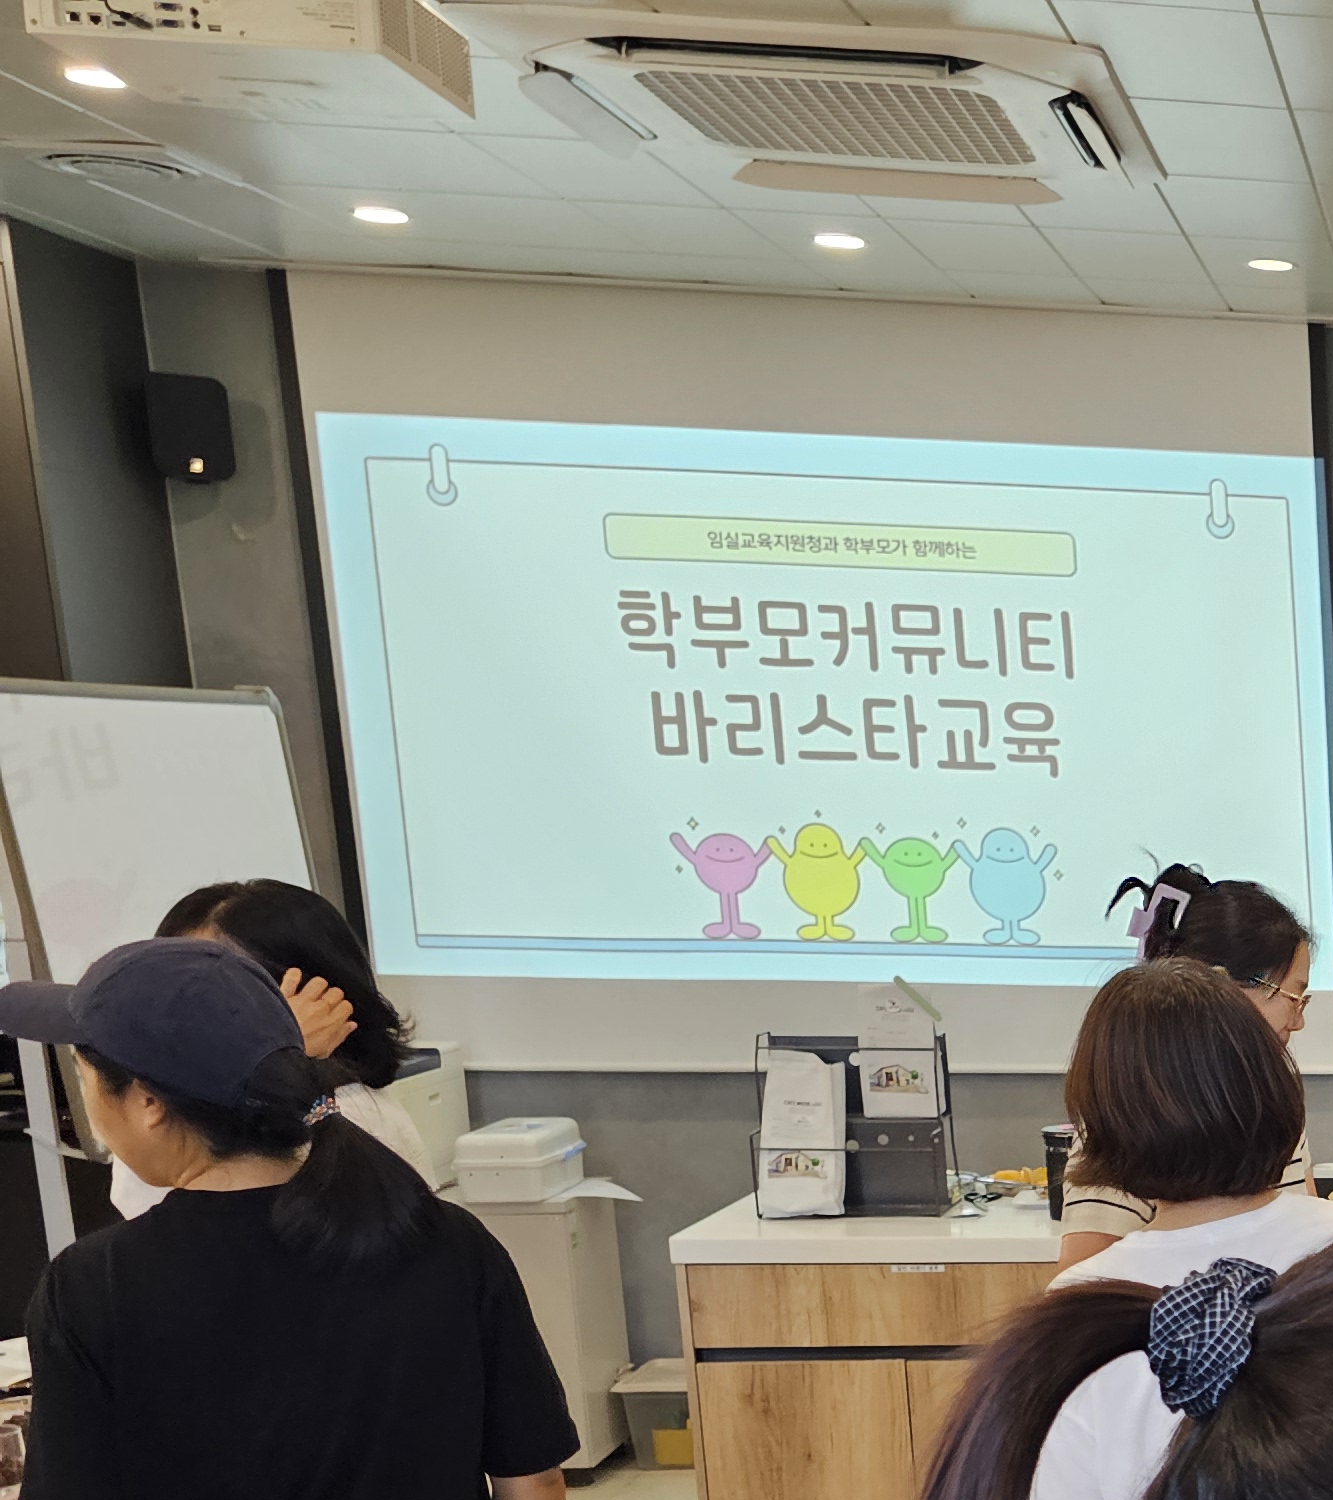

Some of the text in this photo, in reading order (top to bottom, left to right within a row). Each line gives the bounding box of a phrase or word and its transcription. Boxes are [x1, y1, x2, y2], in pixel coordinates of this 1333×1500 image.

[707, 531, 977, 560] 임실교육지원청과 학부모가 함께하는
[617, 589, 1075, 680] 학부모커뮤니티
[650, 689, 1061, 779] 바리스타교육
